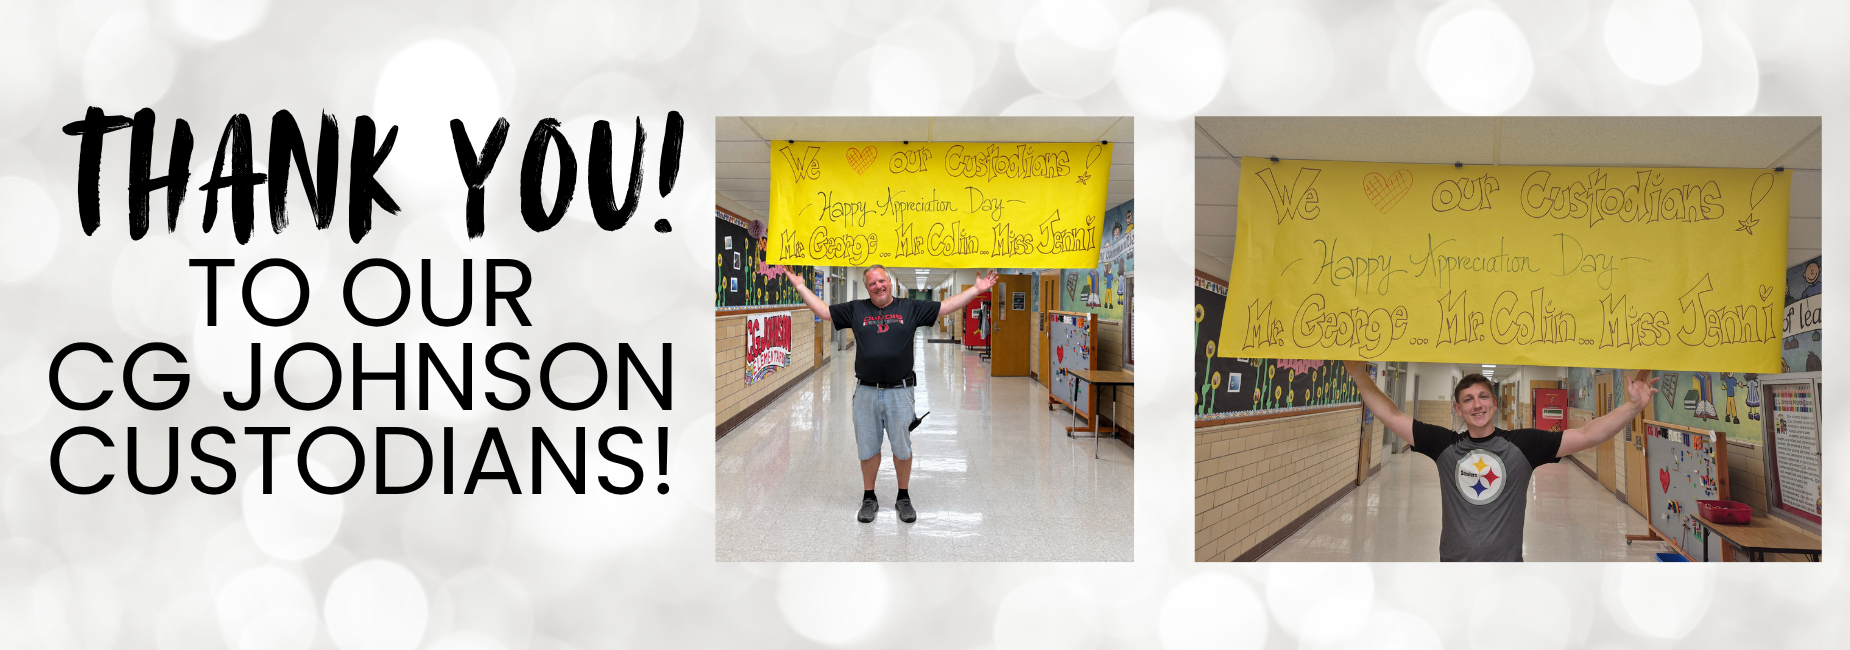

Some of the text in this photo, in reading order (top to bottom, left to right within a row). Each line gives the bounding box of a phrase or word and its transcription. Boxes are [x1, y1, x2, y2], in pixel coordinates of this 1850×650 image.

[779, 146, 821, 183] We
[889, 147, 932, 173] our
[817, 191, 876, 228] Happy
[877, 187, 957, 222] Appreciation
[1255, 167, 1322, 225] We
[1432, 173, 1499, 212] our
[779, 229, 805, 261] Mr.
[895, 222, 924, 259] Mr.
[991, 222, 1034, 258] Miss
[1036, 209, 1096, 255] Jenni
[1313, 238, 1408, 297] Happy
[1409, 233, 1540, 289] Appreciation
[761, 314, 792, 352] JOHNSON
[876, 324, 890, 333] D
[1242, 298, 1284, 351] Mr.
[1435, 289, 1485, 348] Mr.
[1599, 293, 1671, 351] Miss
[1677, 273, 1777, 347] Jenni
